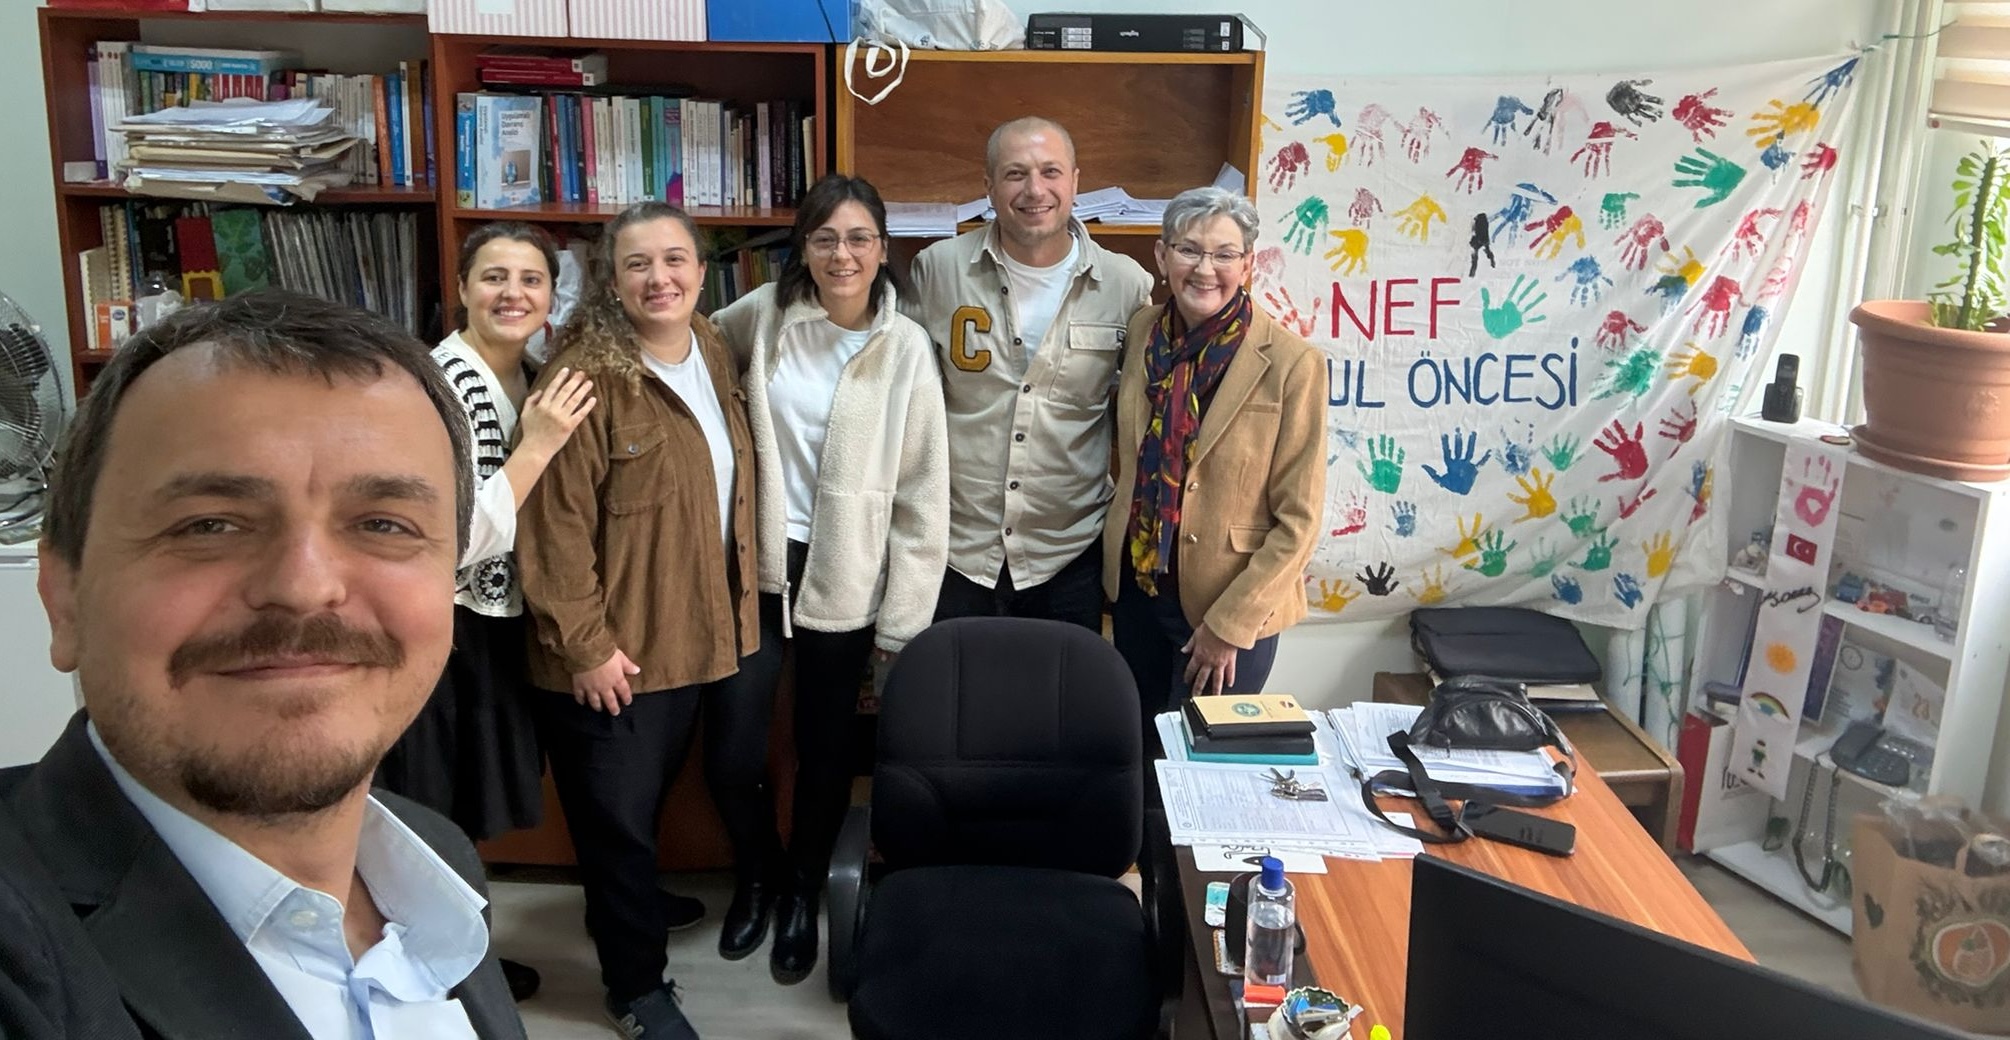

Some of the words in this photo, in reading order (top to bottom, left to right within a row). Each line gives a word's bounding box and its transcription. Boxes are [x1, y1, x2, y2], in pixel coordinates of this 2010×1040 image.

[949, 305, 992, 372] C
[1331, 277, 1462, 341] NEF
[1327, 358, 1386, 408] UL
[1408, 337, 1579, 410] ÖNCESİ
